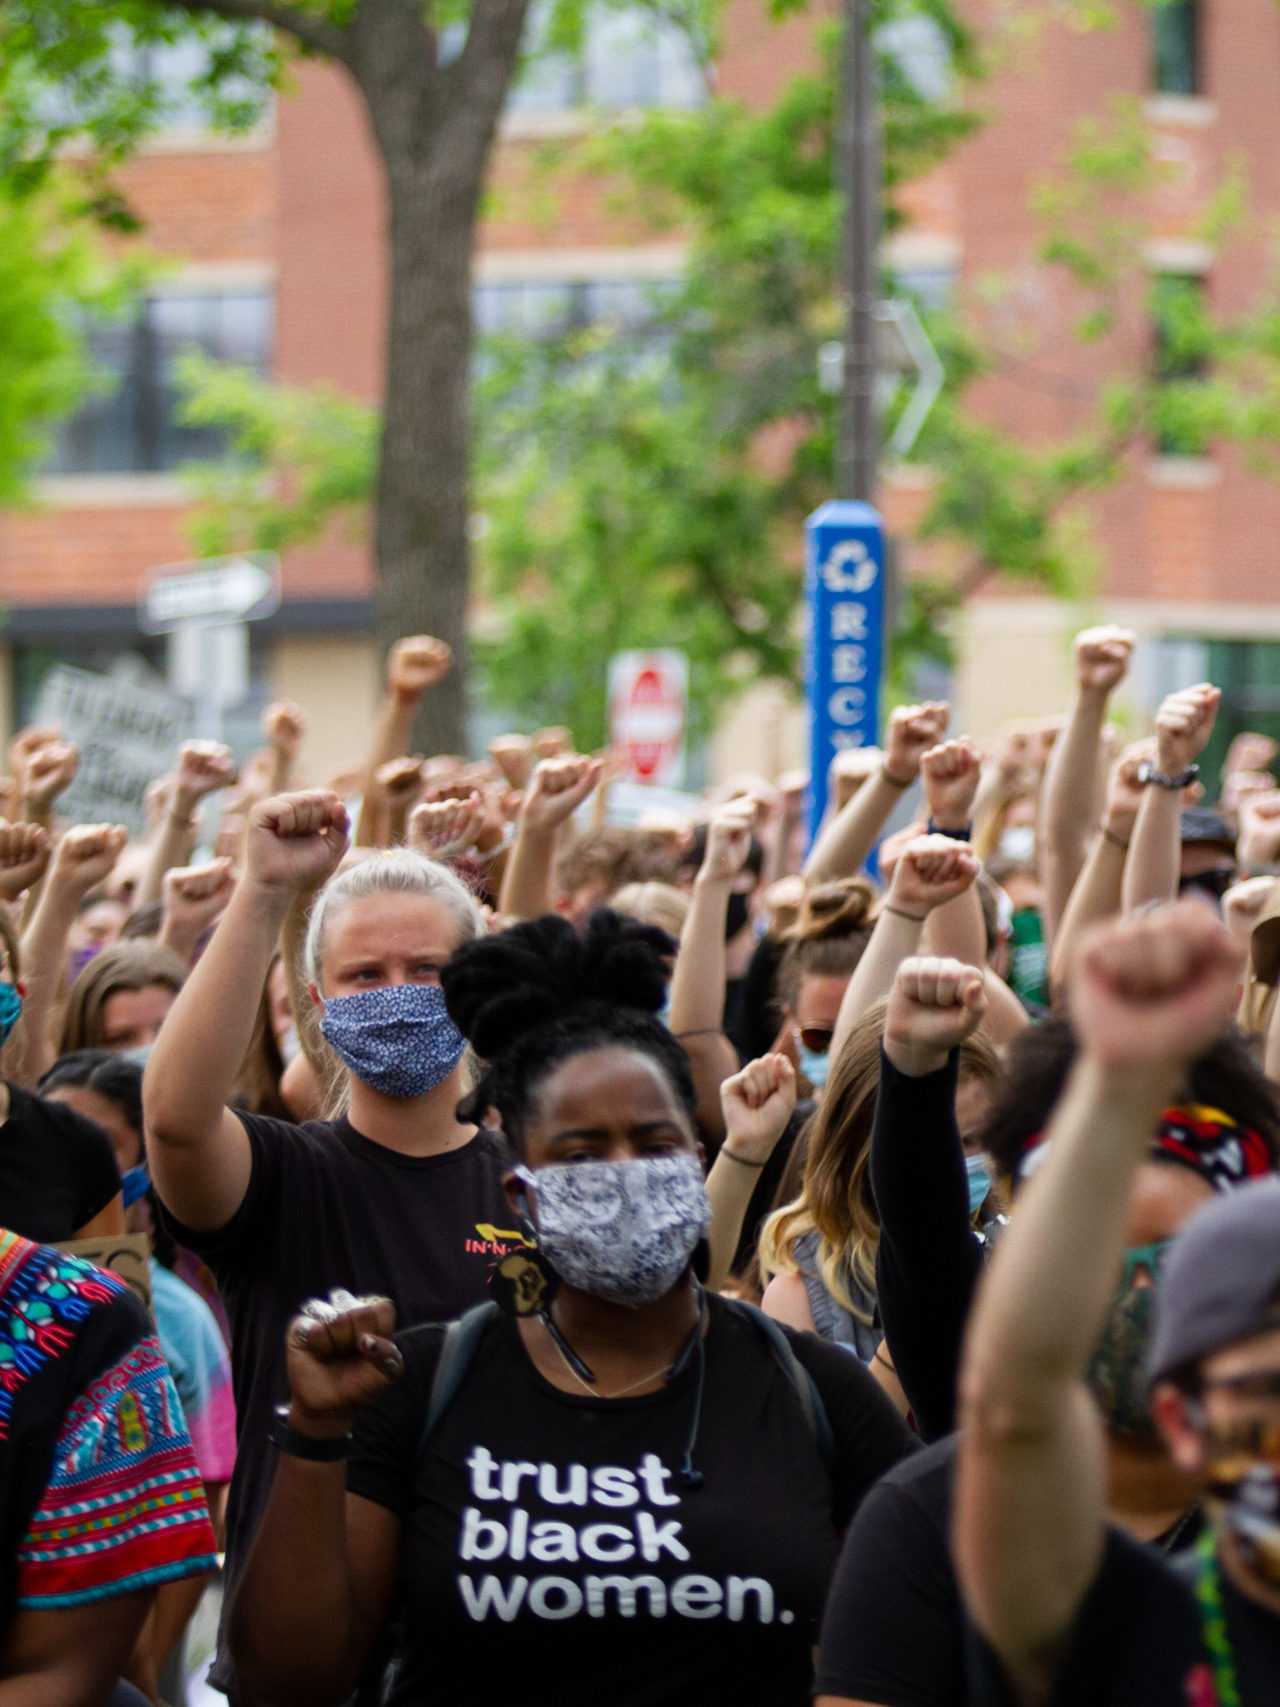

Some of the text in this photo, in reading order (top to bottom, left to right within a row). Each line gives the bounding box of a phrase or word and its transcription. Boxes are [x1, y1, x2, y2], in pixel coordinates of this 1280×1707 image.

[467, 1445, 680, 1506] trust
[460, 1507, 690, 1562] black
[458, 1574, 795, 1624] women.
